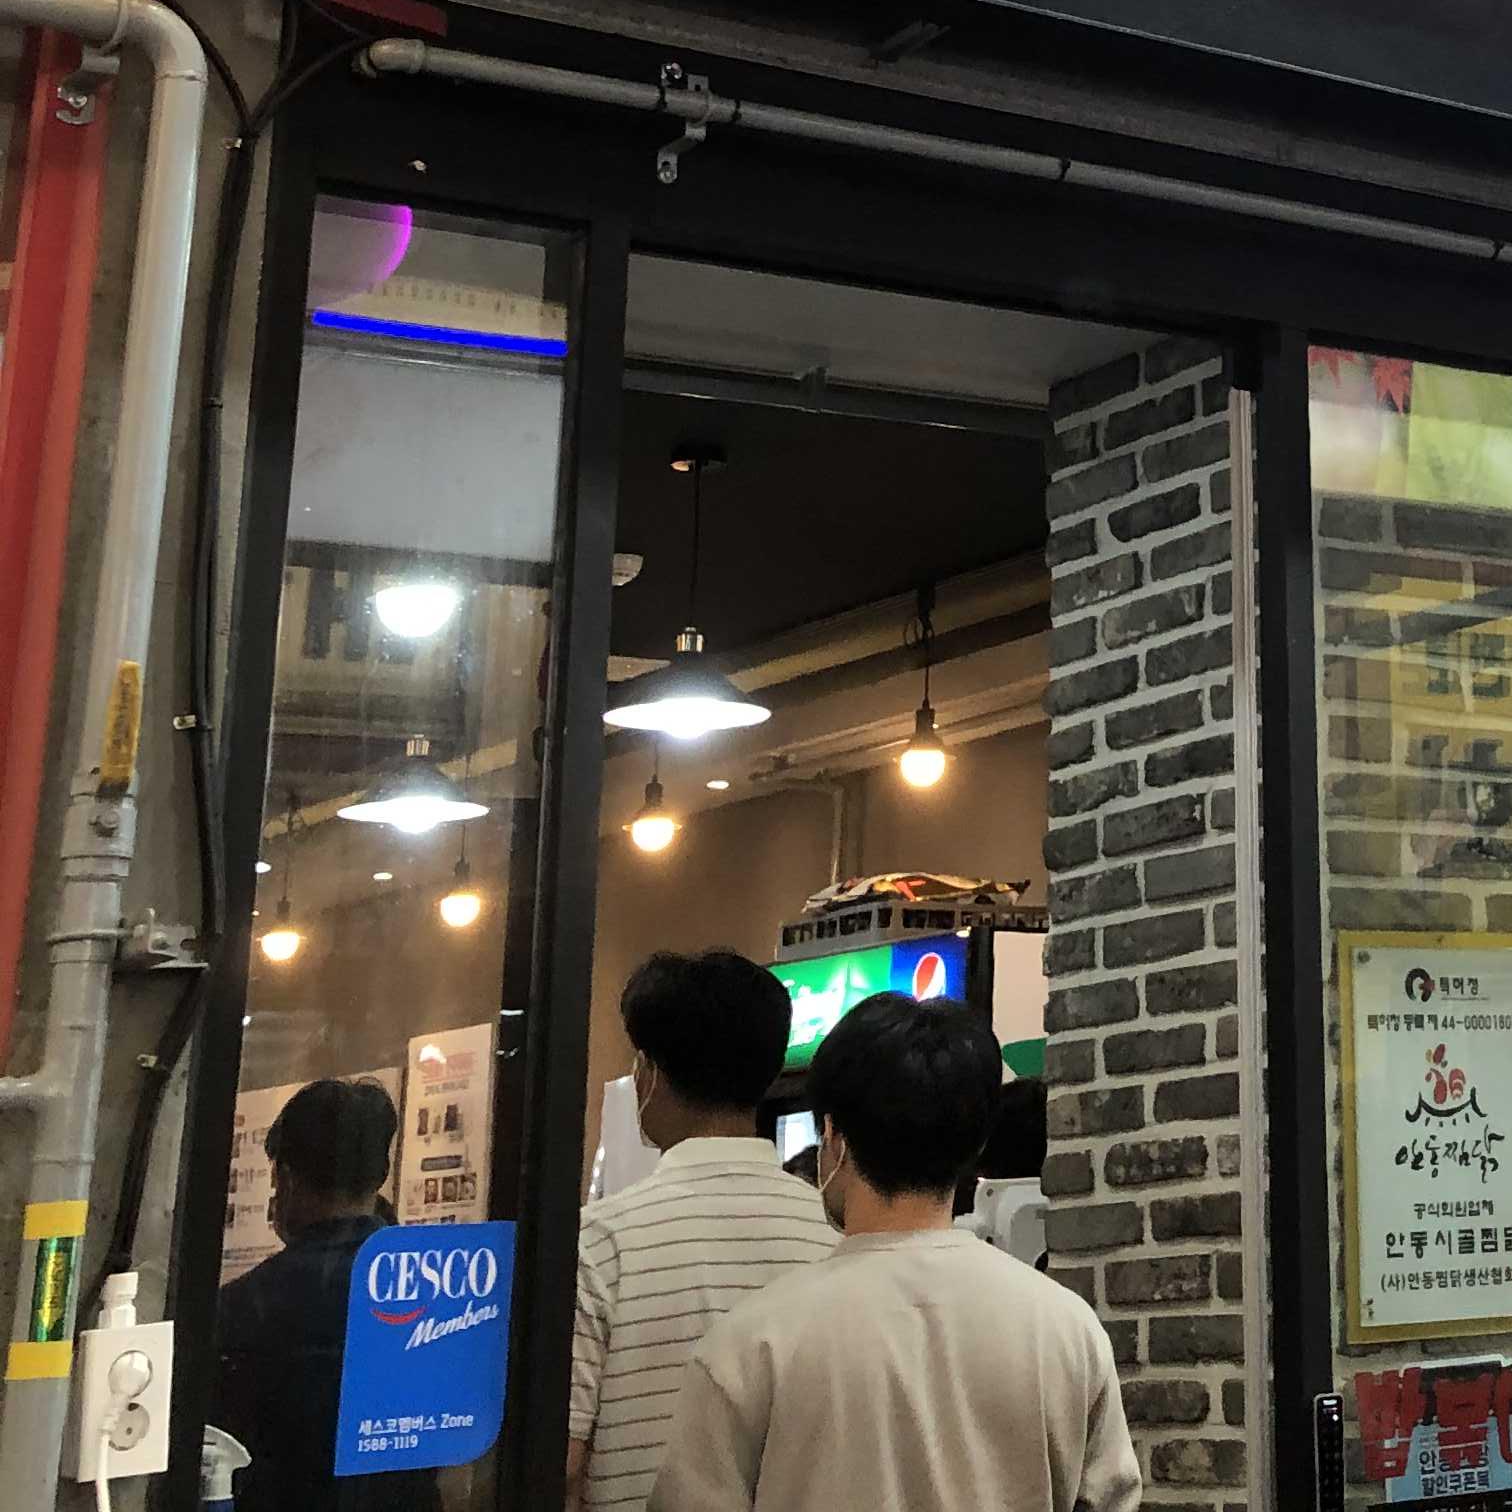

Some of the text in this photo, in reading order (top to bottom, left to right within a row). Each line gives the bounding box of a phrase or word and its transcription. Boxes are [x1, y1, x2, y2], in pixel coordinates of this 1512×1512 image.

[368, 1247, 498, 1303] CESCO
[405, 1299, 499, 1352] Members
[440, 1411, 474, 1429] Zone
[357, 1434, 419, 1453] 1588-1119
